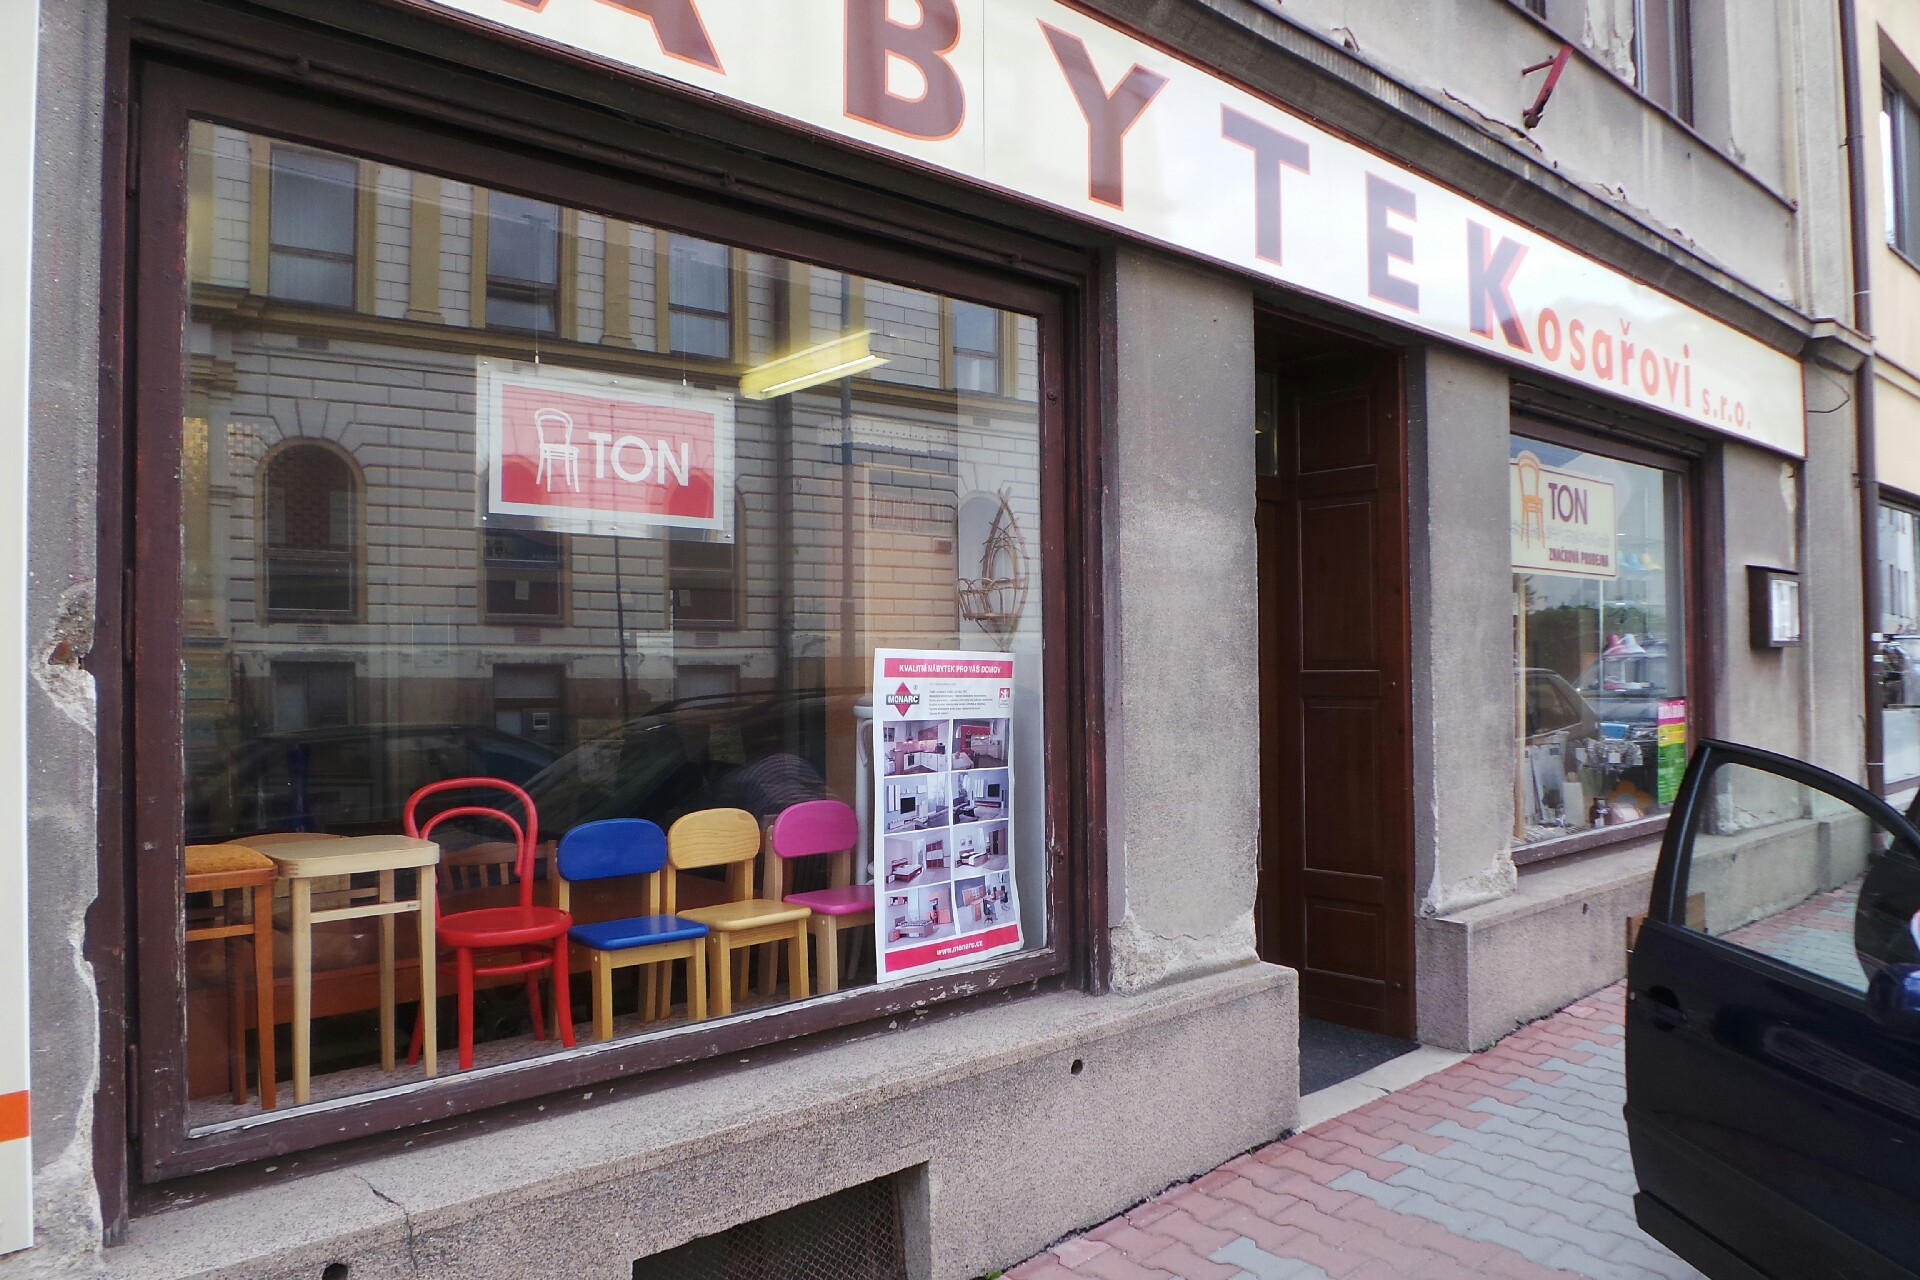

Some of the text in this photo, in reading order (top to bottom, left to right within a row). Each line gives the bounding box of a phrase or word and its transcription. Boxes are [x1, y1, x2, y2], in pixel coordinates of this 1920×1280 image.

[1702, 387, 1751, 431] s.r.o.
[588, 431, 689, 487] TON
[1547, 482, 1588, 525] TON
[899, 664, 1001, 674] KVALITNÍ NÁBYTEK PRO VÁŠ DOMOV
[887, 695, 919, 704] MONARC
[936, 940, 984, 956] www.monarc.cz
